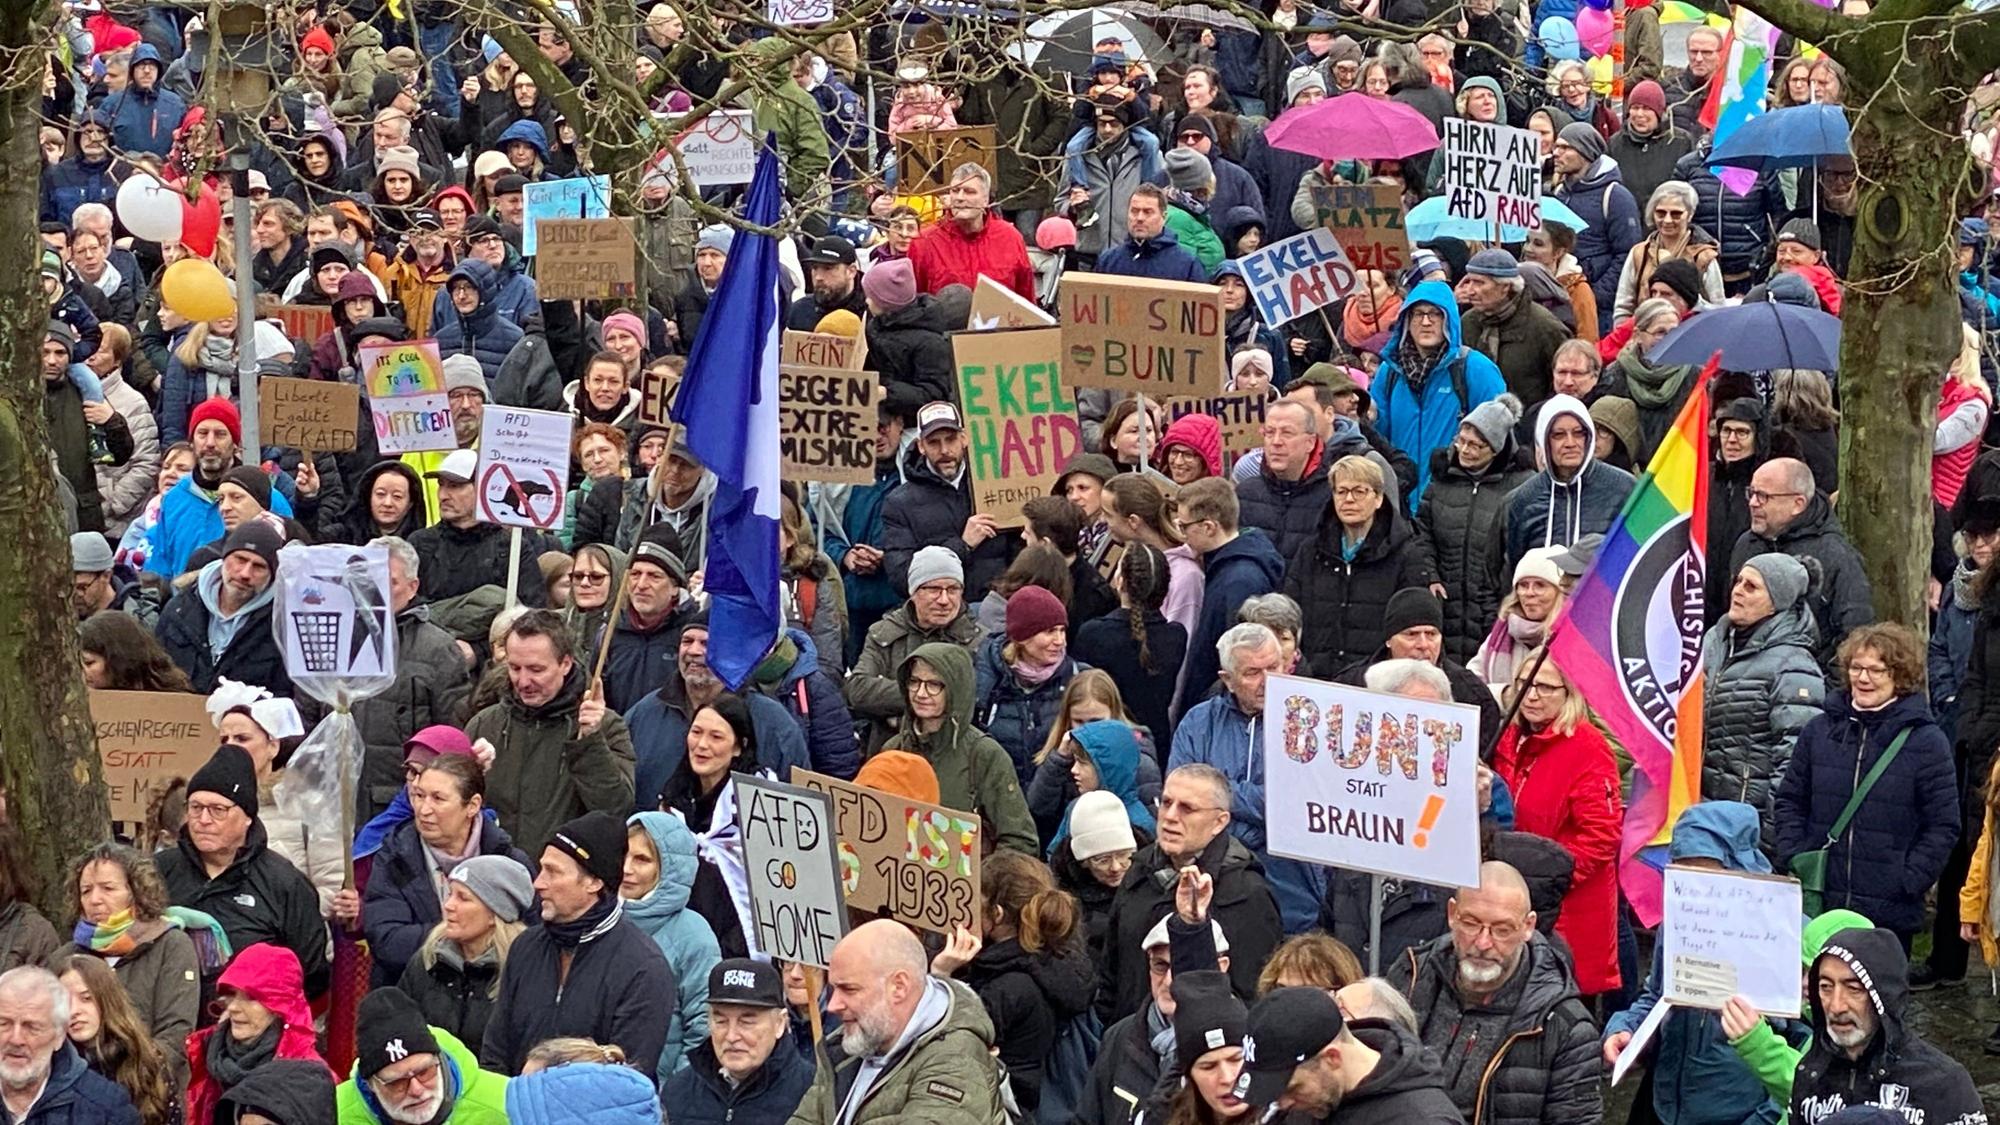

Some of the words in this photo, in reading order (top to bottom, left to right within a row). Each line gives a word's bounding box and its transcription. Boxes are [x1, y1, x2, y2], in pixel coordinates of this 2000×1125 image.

[1447, 120, 1496, 156] HIRN
[1506, 134, 1537, 164] AN
[1448, 153, 1502, 192] HERZ
[1507, 165, 1540, 200] AUF
[1317, 208, 1403, 229] PLATZ
[1448, 186, 1487, 220] AfD
[1497, 195, 1541, 230] RAUS
[1243, 235, 1338, 287] EKEL
[1346, 242, 1403, 271] AZIS
[1256, 261, 1356, 326] HAfD
[1072, 293, 1130, 325] WIR
[1148, 298, 1218, 337] SIND
[796, 340, 844, 368] KEIN
[1104, 340, 1203, 385] BUNT
[274, 382, 330, 403] Liberté
[780, 374, 870, 406] GEGEN
[960, 361, 1077, 417] EKEL
[780, 407, 869, 439] EXTRE-
[780, 436, 875, 469] MISMUS
[970, 414, 1082, 481] HAfD
[96, 719, 201, 745] SCHENRECHTE
[1283, 695, 1462, 787] BUNT
[105, 749, 177, 768] STATT
[1345, 779, 1387, 798] STATT
[904, 806, 977, 878] IST
[766, 858, 796, 890] GO
[875, 855, 974, 931] 1933
[756, 896, 836, 966] HOME
[723, 976, 755, 989] DONE
[385, 1038, 408, 1063] NY
